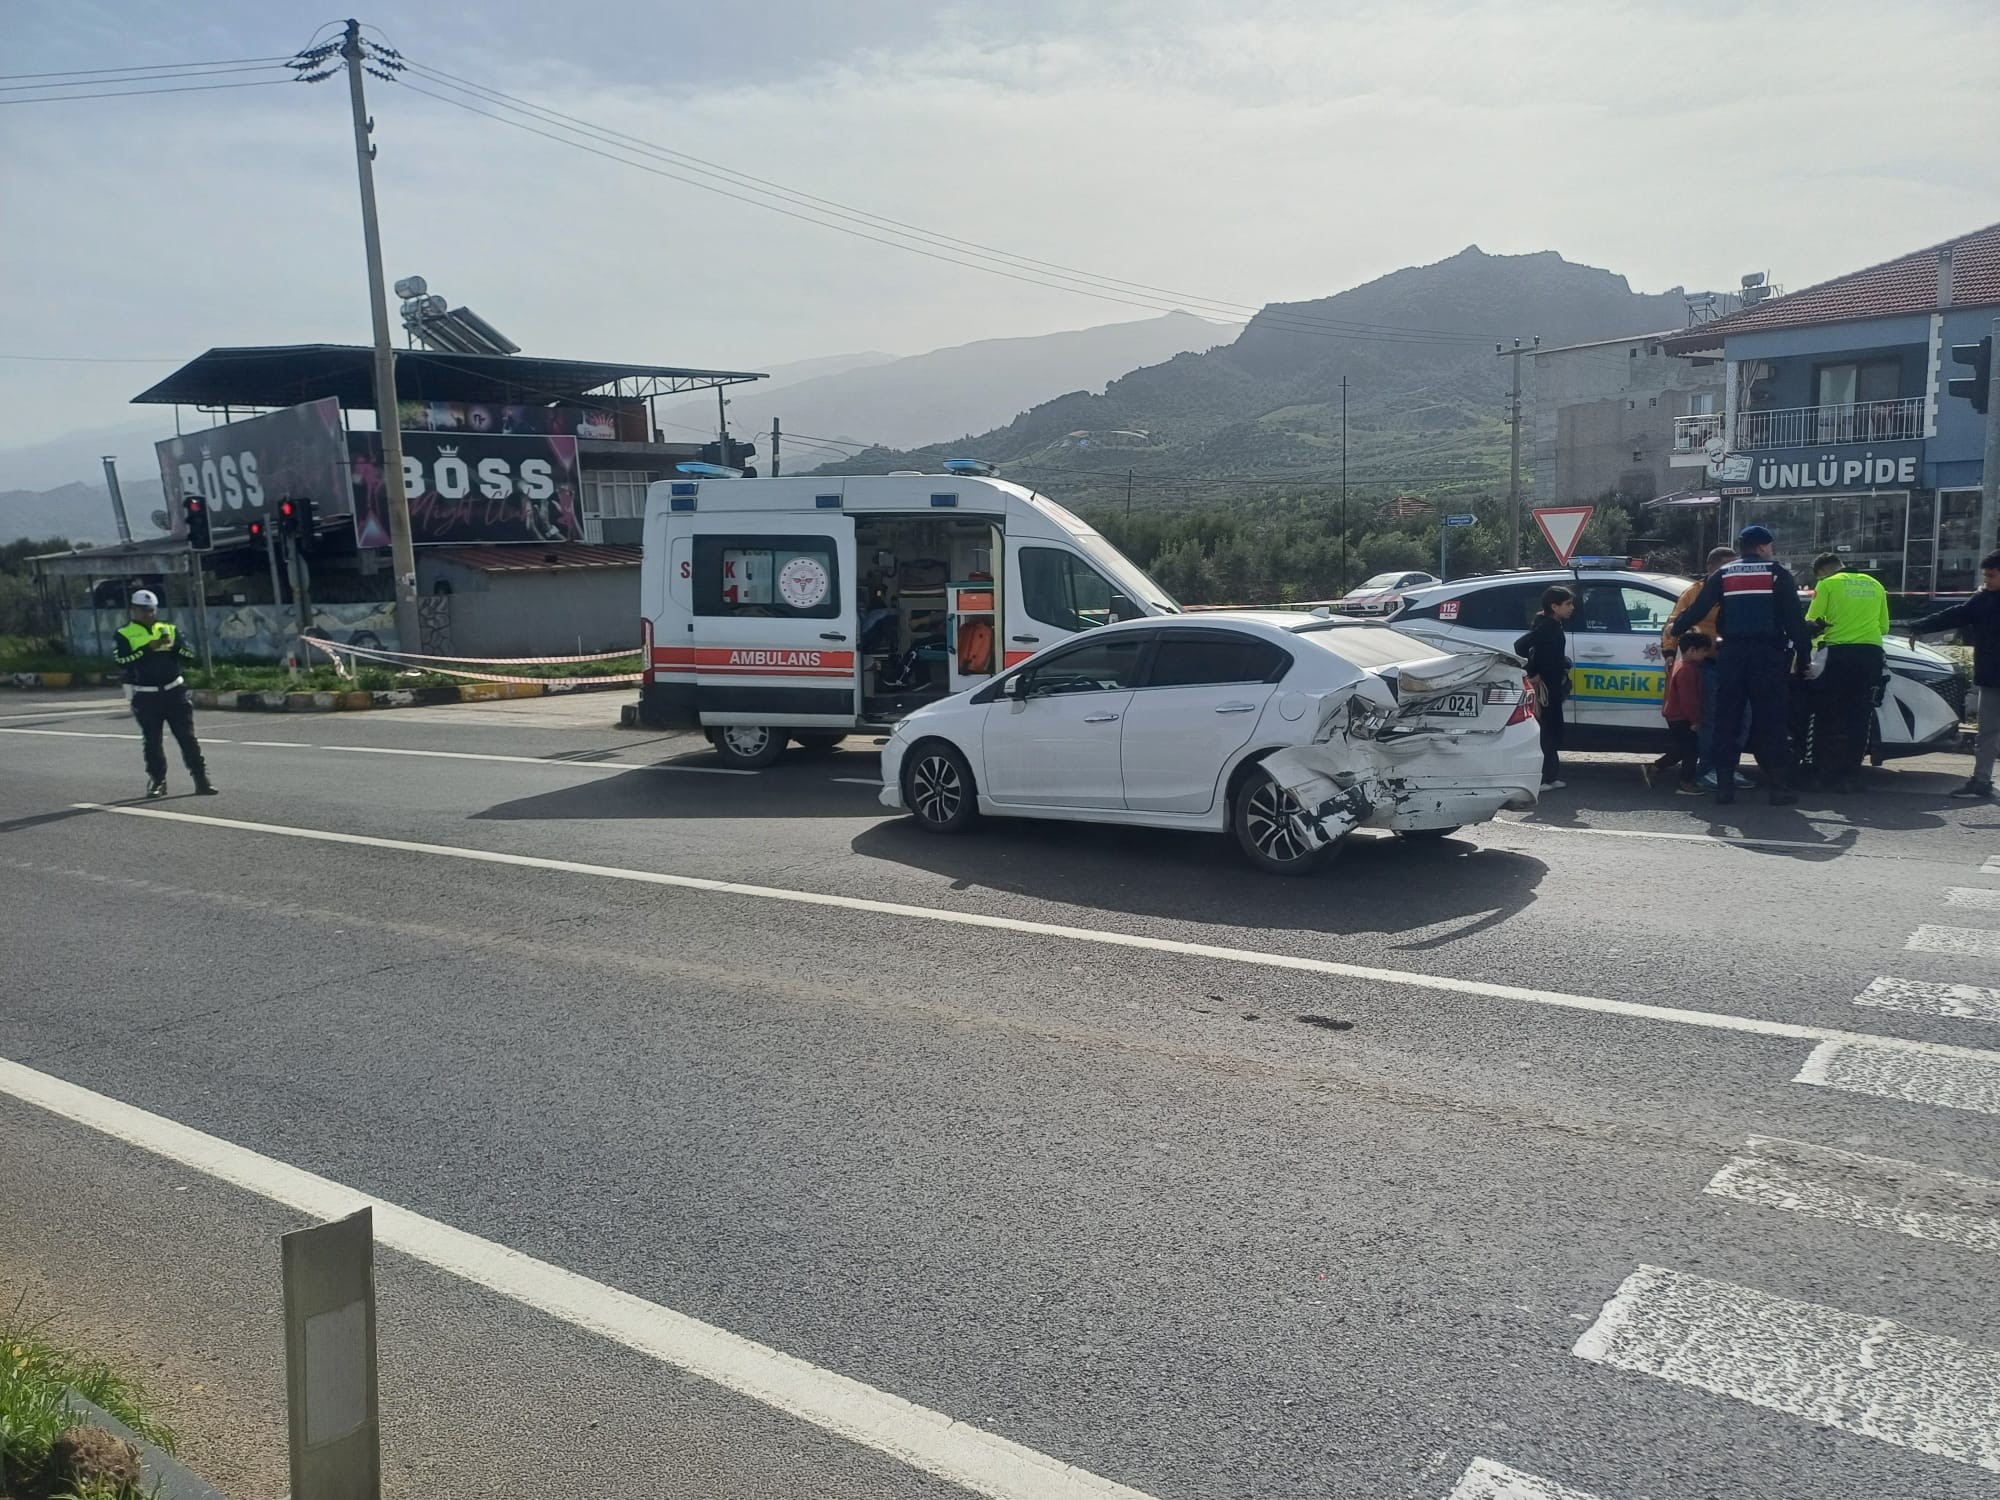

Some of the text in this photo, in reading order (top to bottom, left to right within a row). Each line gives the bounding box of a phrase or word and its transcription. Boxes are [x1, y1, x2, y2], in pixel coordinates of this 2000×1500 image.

[178, 450, 264, 512] BOSS
[401, 456, 554, 499] BOSS
[1758, 454, 1838, 489] ÜNLÜ
[1844, 452, 1917, 485] PİDE
[1443, 603, 1457, 613] 112
[729, 651, 821, 667] AMBULANS
[1583, 671, 1651, 692] TRAFİK
[1449, 695, 1474, 712] 024
